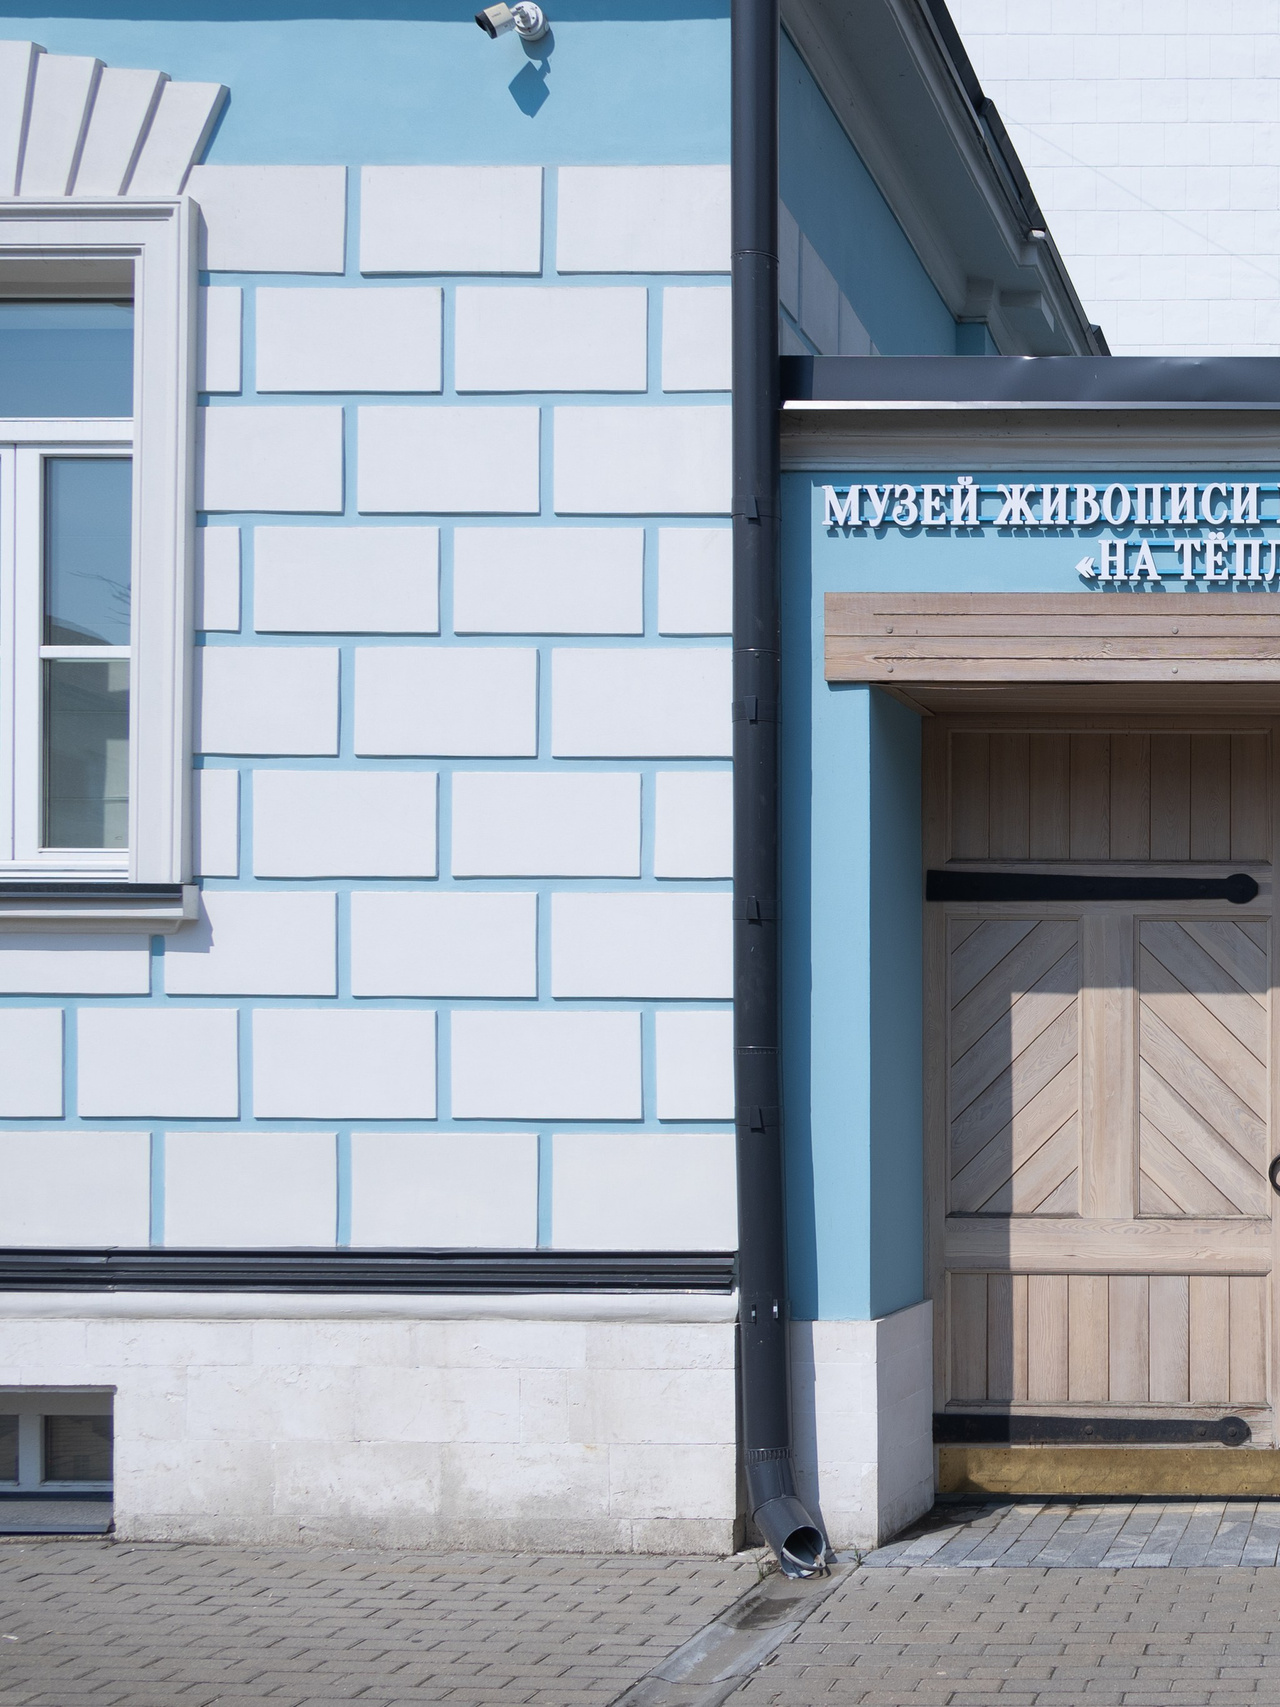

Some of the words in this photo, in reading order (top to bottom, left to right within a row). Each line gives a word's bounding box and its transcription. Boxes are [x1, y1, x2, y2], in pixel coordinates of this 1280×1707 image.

[822, 476, 981, 527] МУЗЕЙ
[993, 483, 1261, 526] ЖИВОПИСИ
[1074, 539, 1161, 582] «НА
